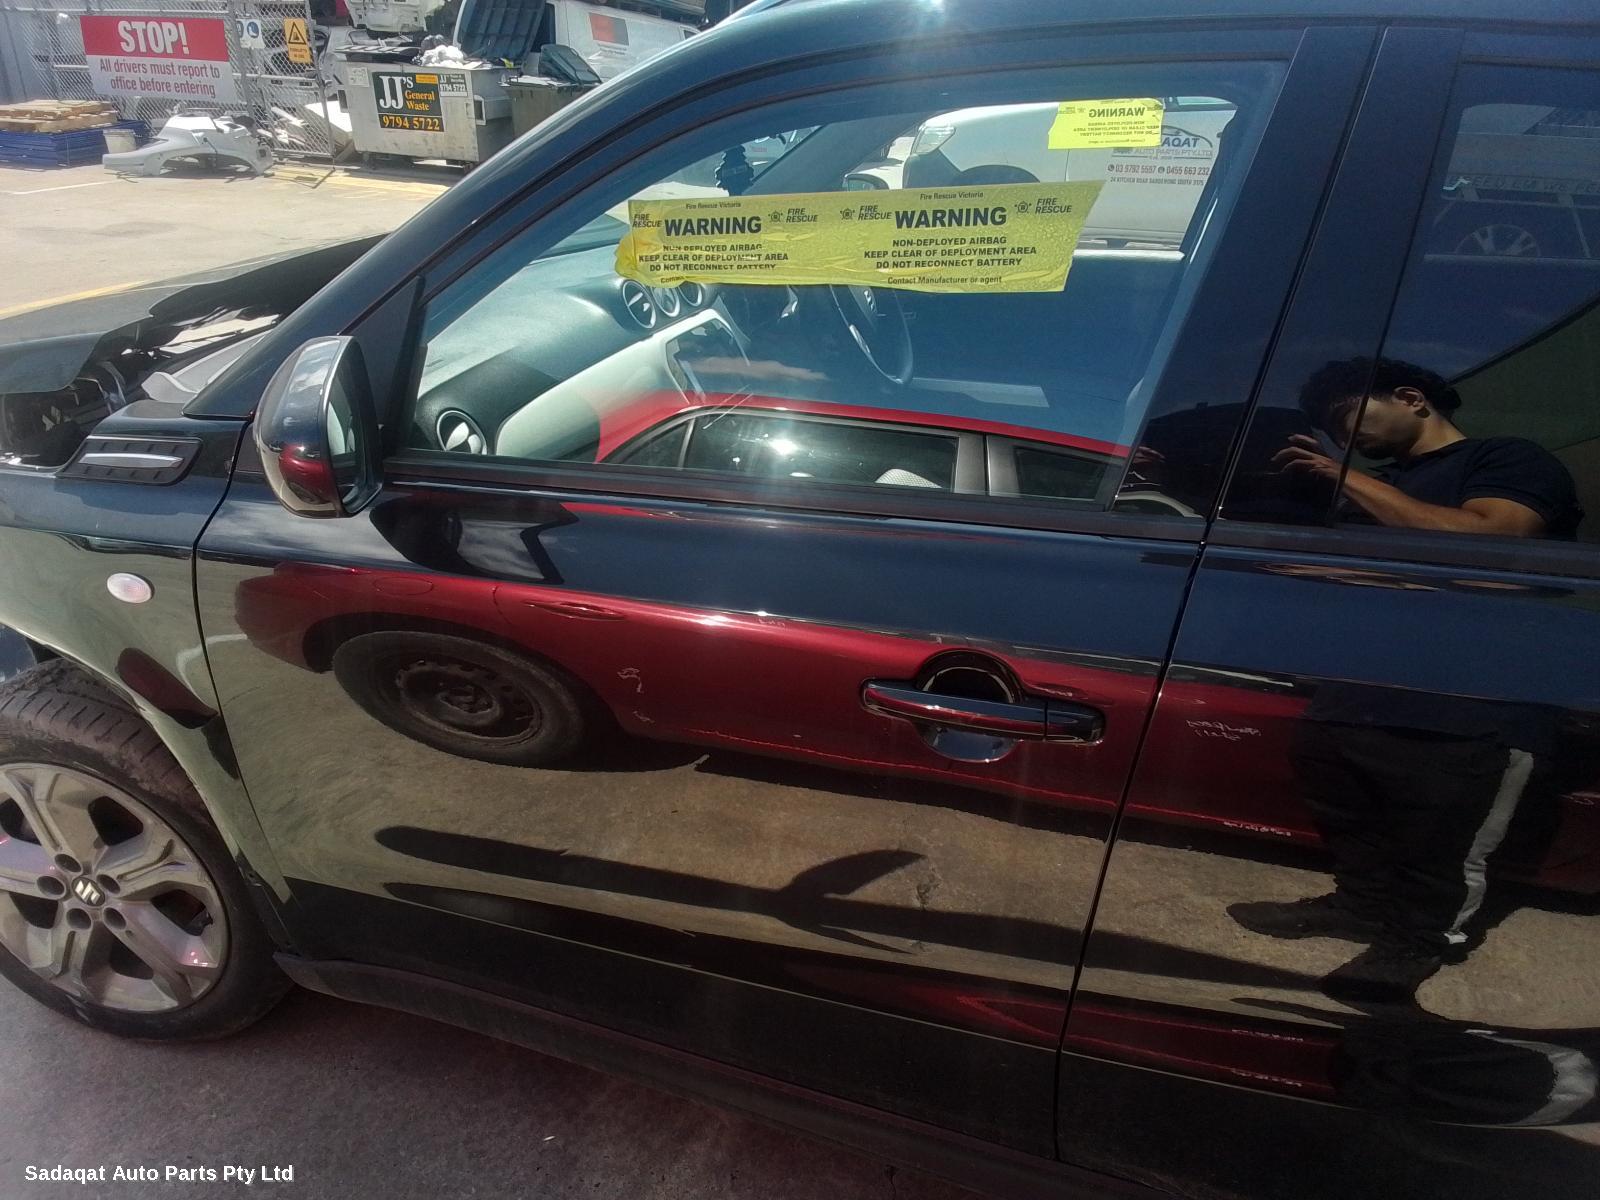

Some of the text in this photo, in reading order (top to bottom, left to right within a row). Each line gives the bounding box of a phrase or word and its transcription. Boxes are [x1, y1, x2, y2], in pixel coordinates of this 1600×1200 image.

[118, 20, 190, 55] STOP!
[100, 60, 220, 79] All drivers must report to
[111, 76, 216, 98] office before entering
[405, 90, 435, 100] General
[406, 101, 429, 110] Waste
[383, 116, 440, 130] 9794 5722
[1167, 166, 1182, 174] 0455
[1197, 167, 1209, 175] 232
[958, 191, 983, 199] Victoria
[1037, 198, 1057, 206] FIRE
[787, 208, 805, 216] FIRE
[1035, 205, 1072, 214] RESCUE
[786, 215, 817, 223] RESCUE
[857, 212, 892, 220] RESCUE
[895, 207, 1007, 229] WARNING
[632, 220, 661, 228] RESCUE
[665, 216, 762, 236] WARNING
[892, 236, 1007, 247] NON-DEPLOYED AIRBAG
[864, 246, 1037, 259] KEEP CLEAR OF DEPLOYMENT AREA
[639, 255, 659, 263] KEEP
[662, 254, 689, 262] CLEAR
[650, 264, 661, 272] DO
[683, 263, 735, 271] RECONNECT
[876, 258, 1022, 269] DO NOT RECONNECT BATTERY
[661, 276, 685, 284] Contac
[888, 276, 916, 285] Contact
[917, 276, 968, 284] Manufacturer
[980, 276, 1002, 285] agent
